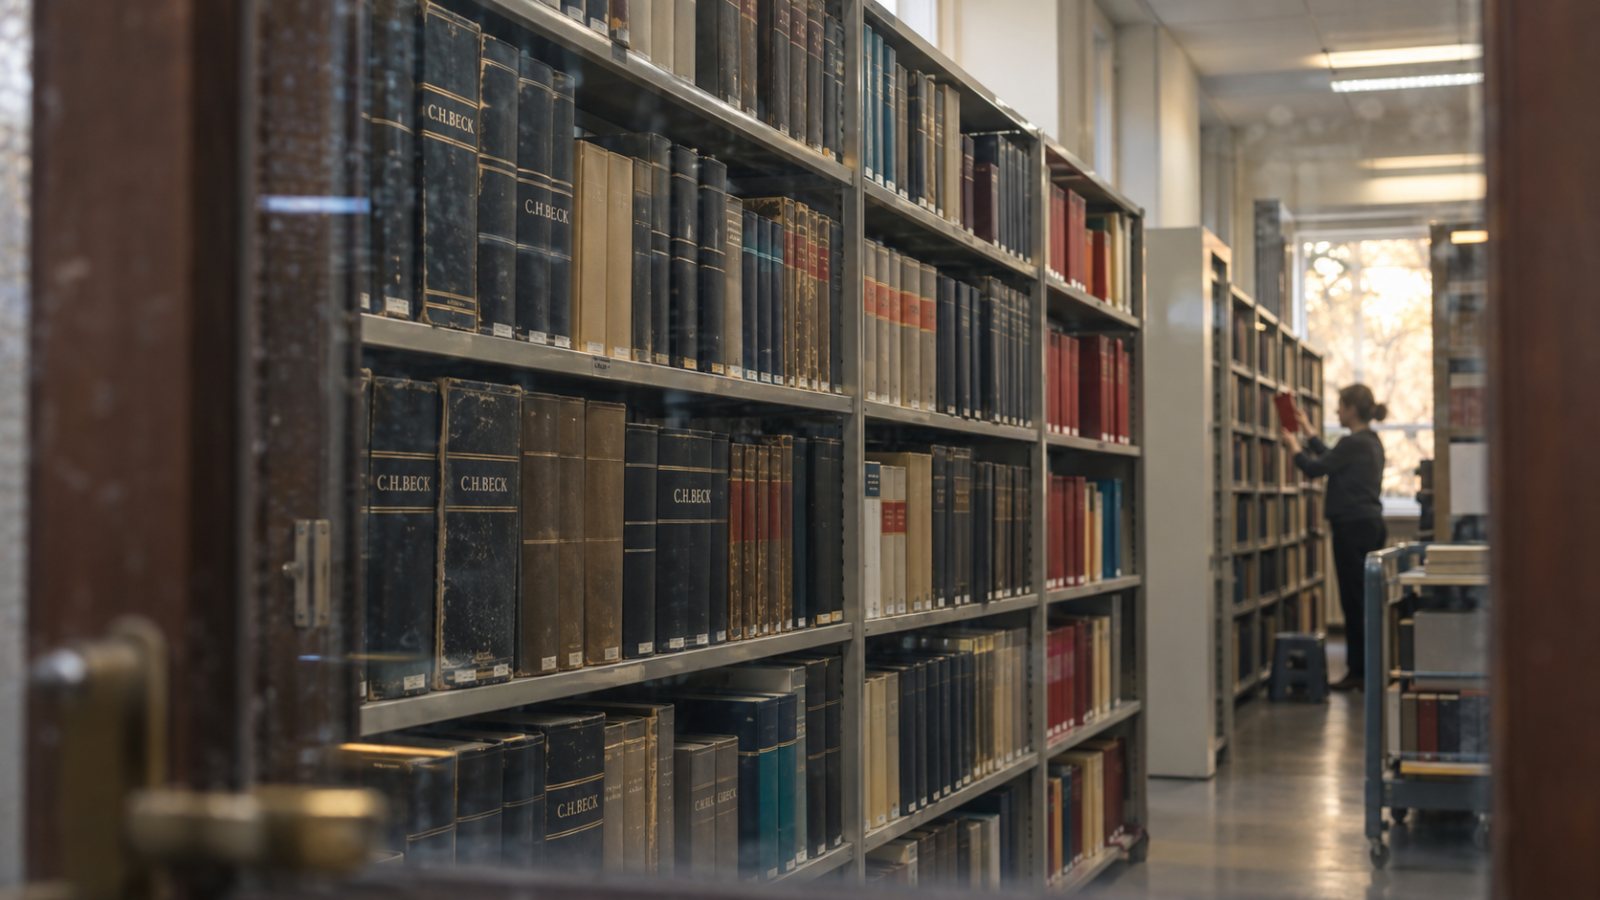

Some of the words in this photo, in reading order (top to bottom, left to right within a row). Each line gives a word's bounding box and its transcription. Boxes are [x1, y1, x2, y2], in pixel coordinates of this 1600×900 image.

[428, 104, 474, 134] C.H.BECK
[525, 199, 569, 224] C.H.BECK
[377, 474, 431, 492] C.H.BECK
[460, 475, 507, 492] C.H.BECK
[673, 488, 711, 504] C.H.BECK
[557, 793, 598, 818] C.H.BECK
